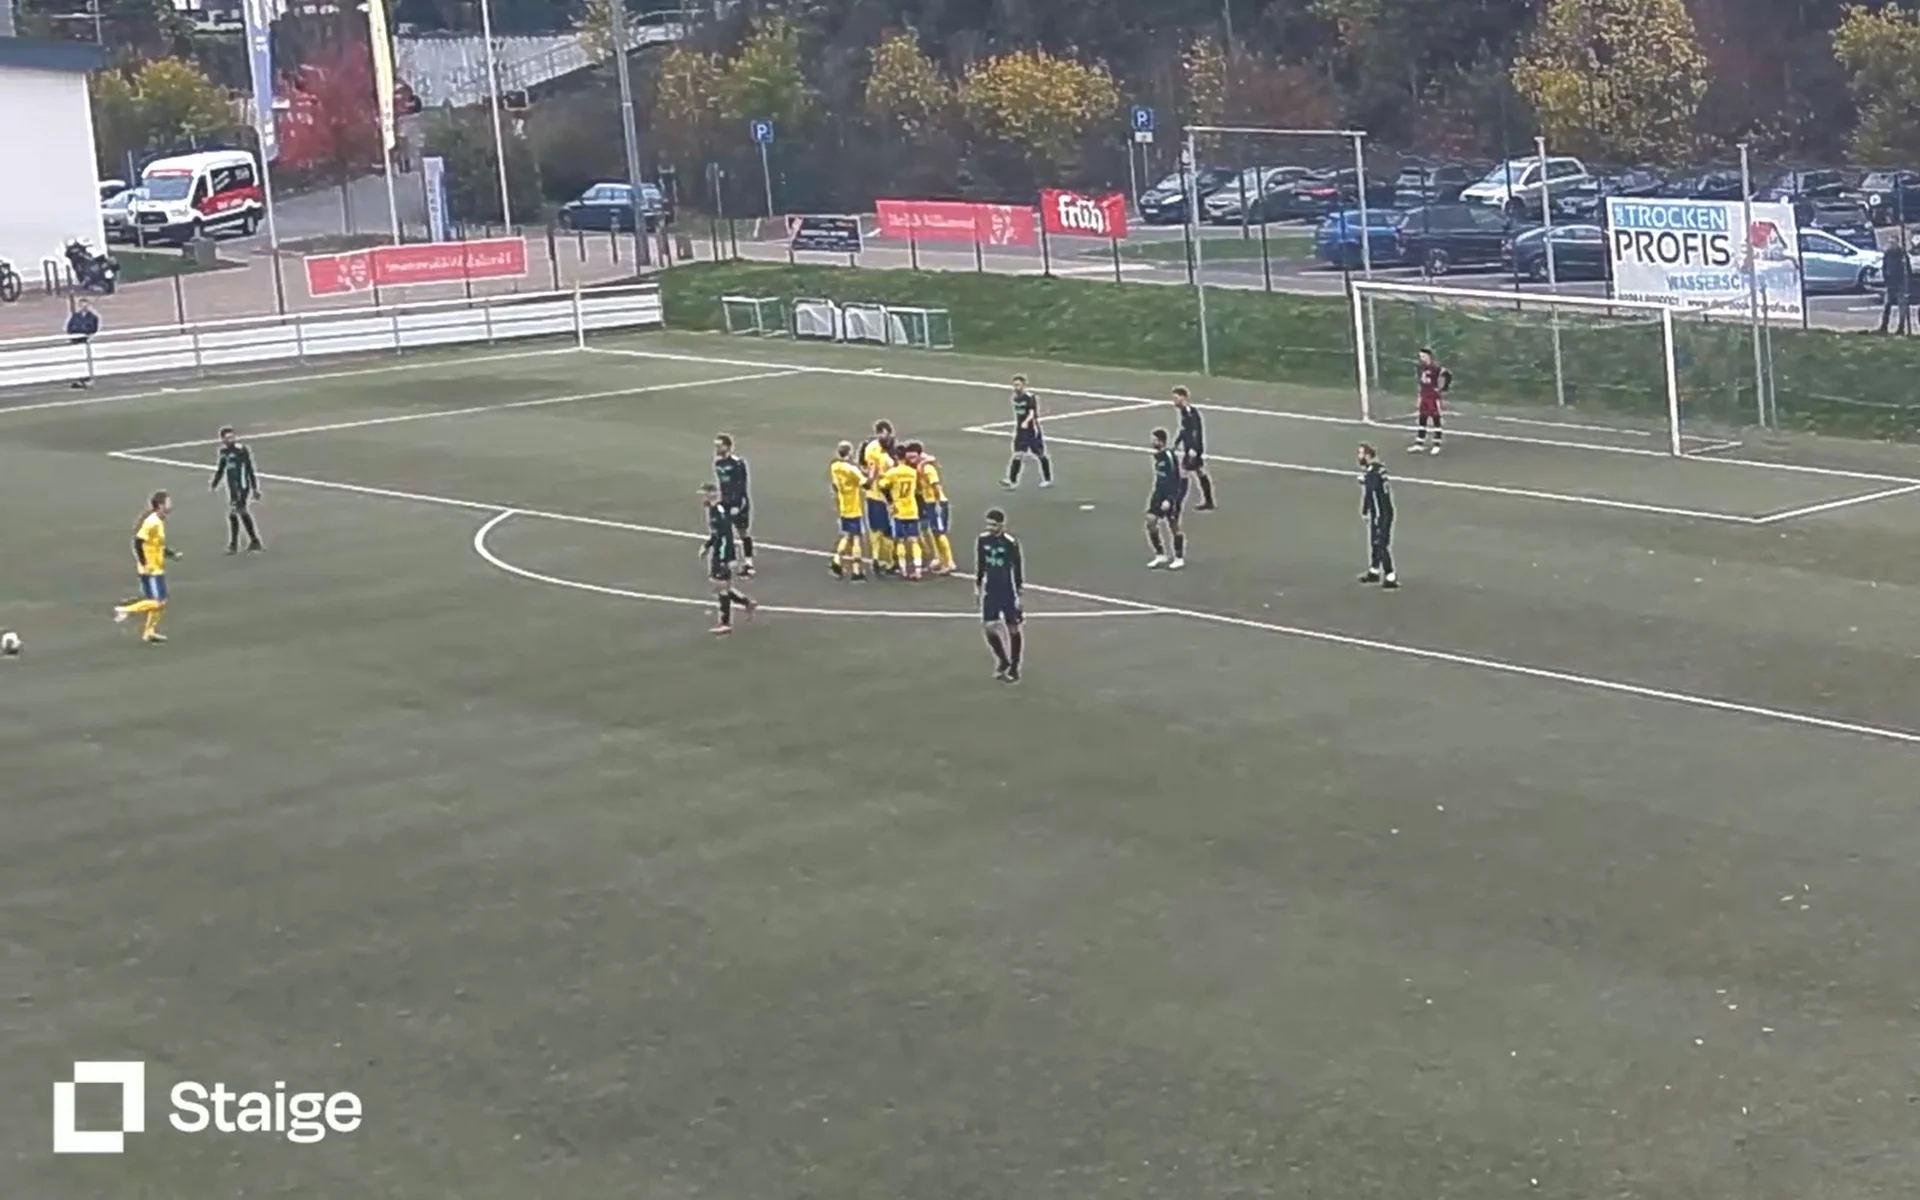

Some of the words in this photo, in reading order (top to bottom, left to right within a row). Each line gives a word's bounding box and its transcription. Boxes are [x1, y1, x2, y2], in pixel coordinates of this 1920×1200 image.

[1137, 110, 1148, 127] P
[756, 124, 768, 140] P
[1624, 204, 1726, 230] TROCKEN
[1614, 229, 1730, 266] PROFIS
[1665, 271, 1797, 292] WASSERSCH
